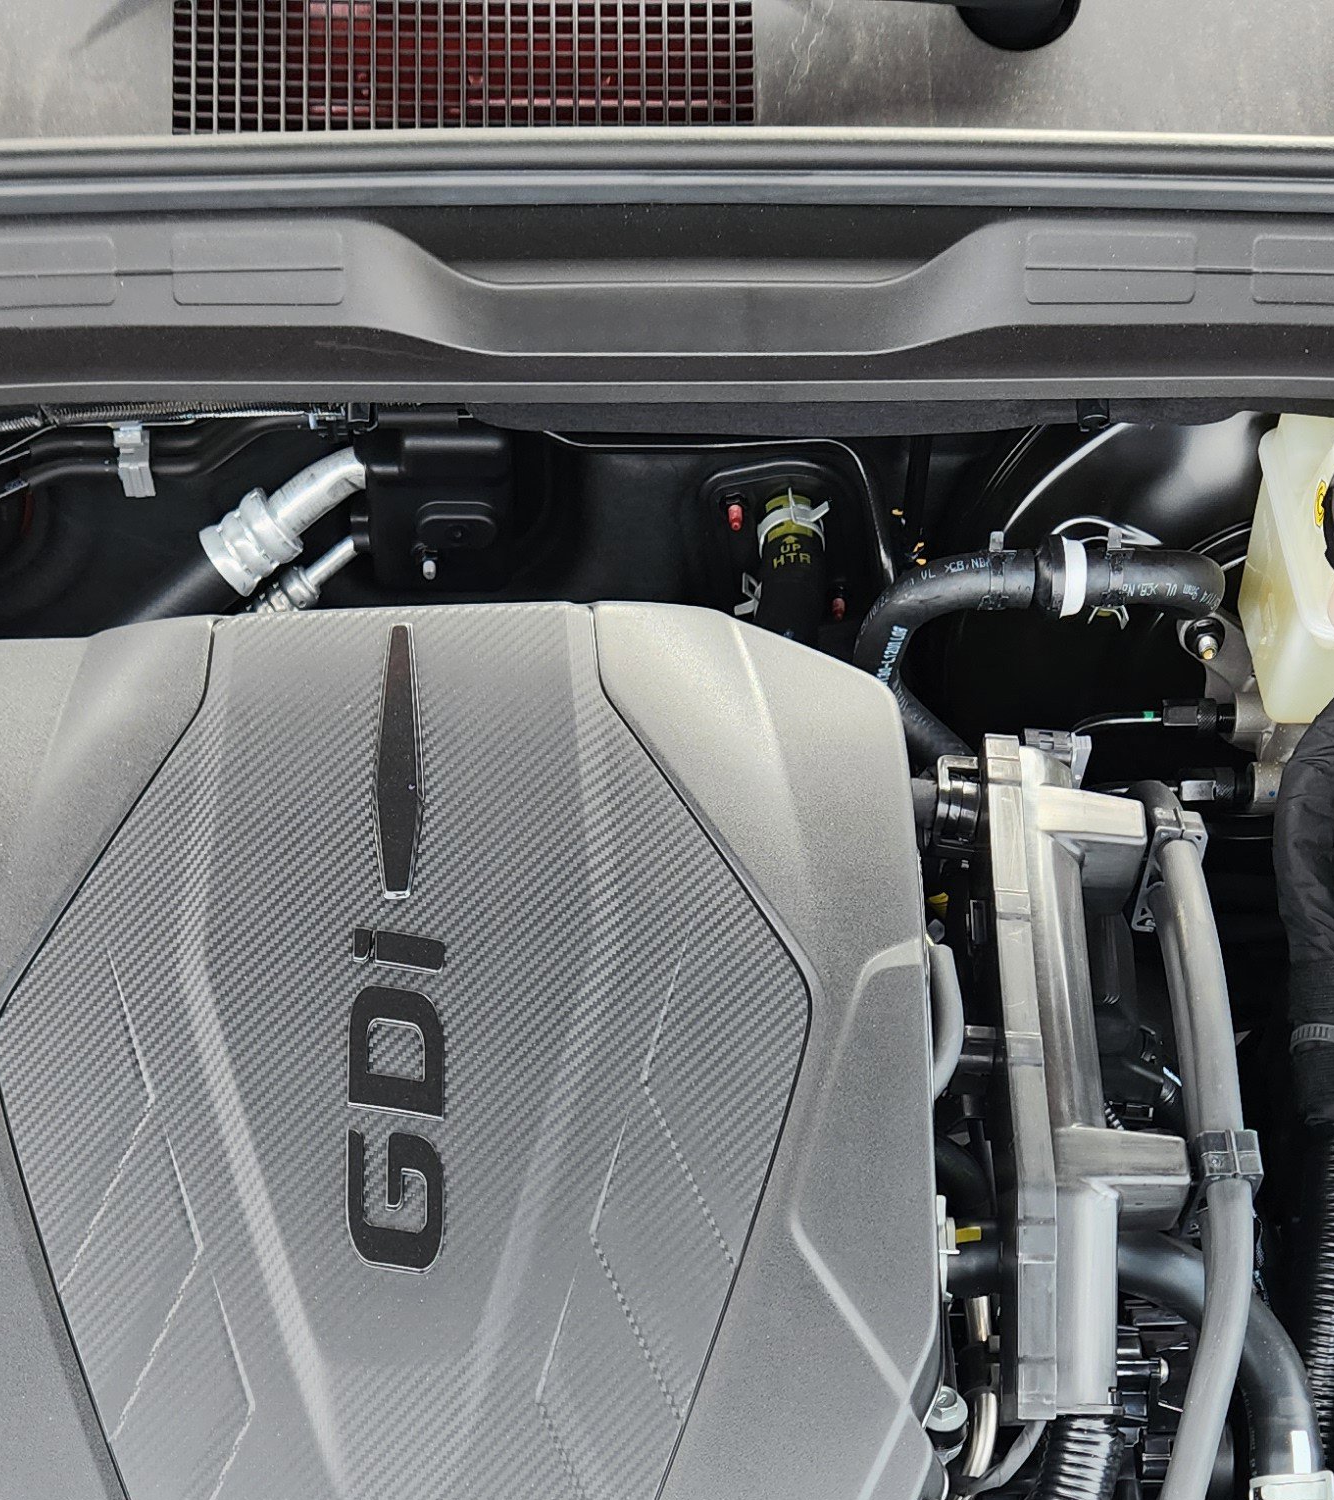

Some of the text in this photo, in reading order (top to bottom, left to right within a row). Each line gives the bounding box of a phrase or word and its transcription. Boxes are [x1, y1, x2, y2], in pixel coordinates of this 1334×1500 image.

[780, 543, 801, 553] UP
[773, 553, 811, 569] HTR
[347, 927, 445, 1274] GDi
